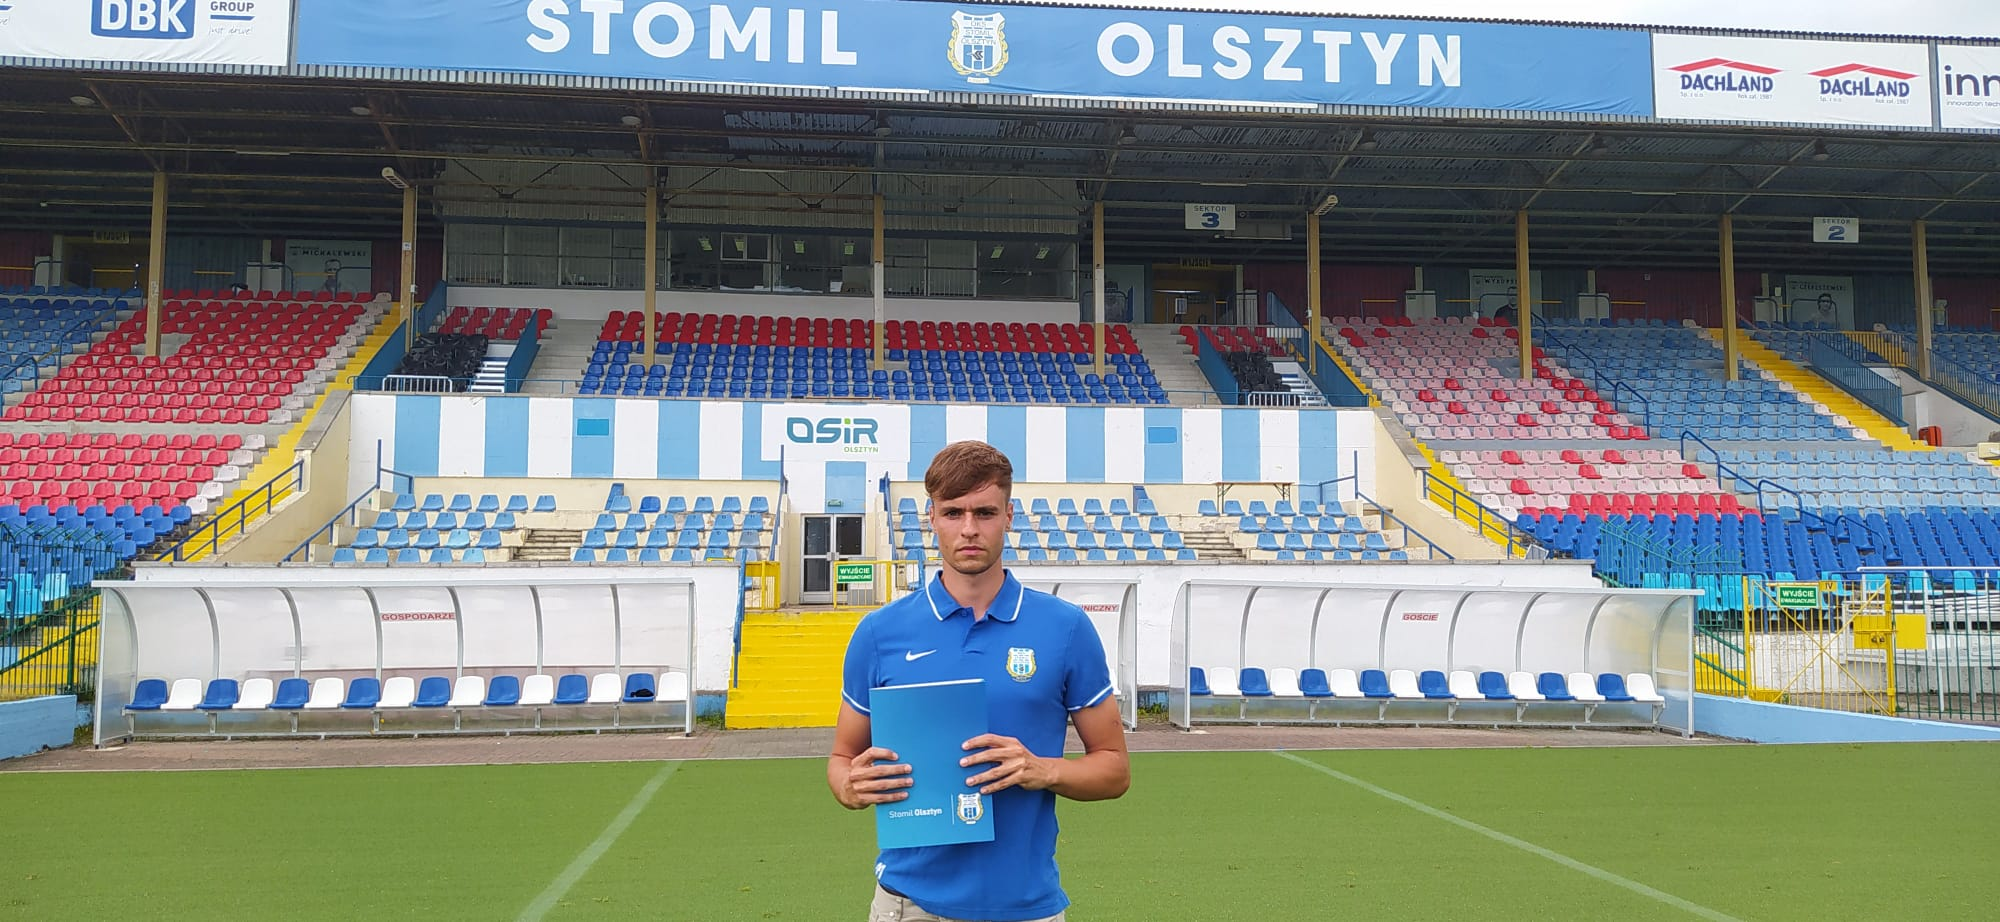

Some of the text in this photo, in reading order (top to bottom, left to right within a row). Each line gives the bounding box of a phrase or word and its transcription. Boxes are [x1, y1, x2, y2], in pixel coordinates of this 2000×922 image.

[210, 1, 255, 12] GROUP
[101, 0, 187, 33] DBK
[525, 0, 1461, 87] STOMIL OLSZTYN
[1680, 71, 1774, 93] DACHLAND
[1820, 77, 1910, 98] DACHLAND
[1193, 205, 1227, 213] SEKTOR
[1201, 212, 1220, 228] 3
[1828, 226, 1845, 241] 2
[302, 249, 367, 257] MICHALEWSKI
[1825, 582, 1834, 590] IV
[1781, 589, 1815, 598] WYJŚCIE
[1081, 604, 1118, 612] NICZNY
[381, 612, 455, 621] GOSPODARZE
[888, 807, 943, 819] Stomil Olsztyn
